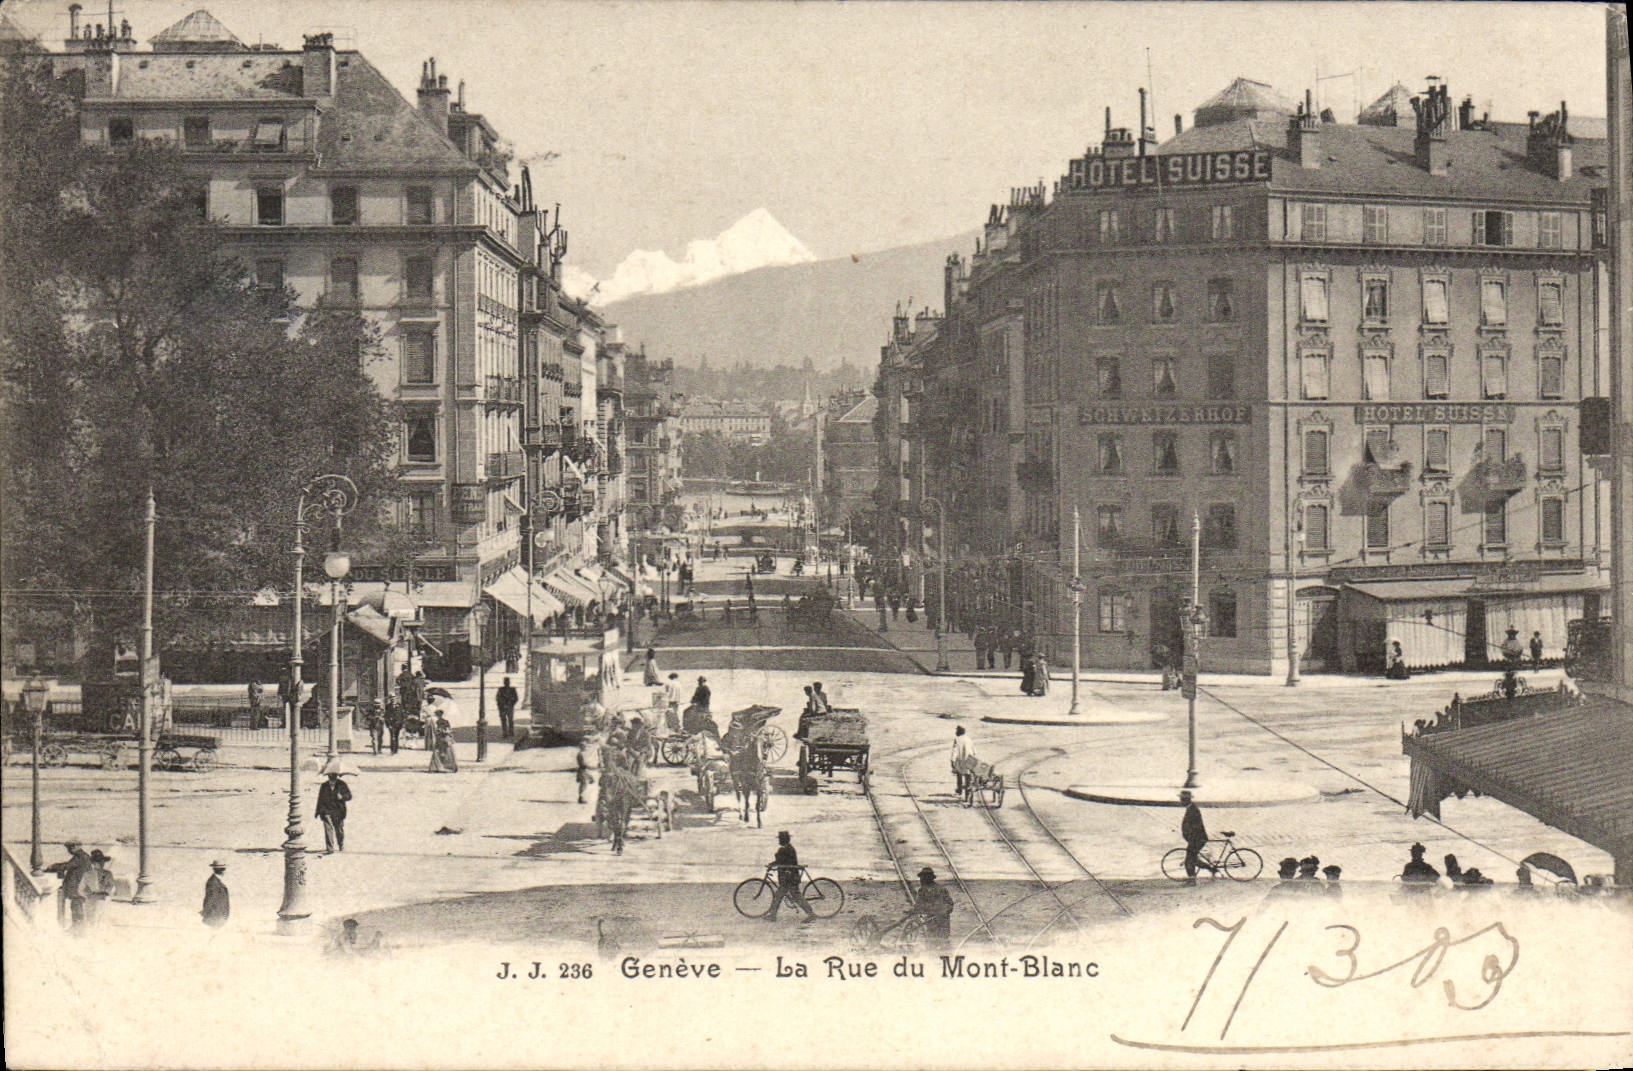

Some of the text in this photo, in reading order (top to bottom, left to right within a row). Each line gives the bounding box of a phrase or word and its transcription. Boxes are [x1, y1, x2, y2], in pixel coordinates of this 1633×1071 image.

[1072, 151, 1270, 188] HOTEL SUISSE
[1081, 405, 1249, 423] SCHWEIZERHOF
[1364, 405, 1510, 421] HOTEL SUISSE
